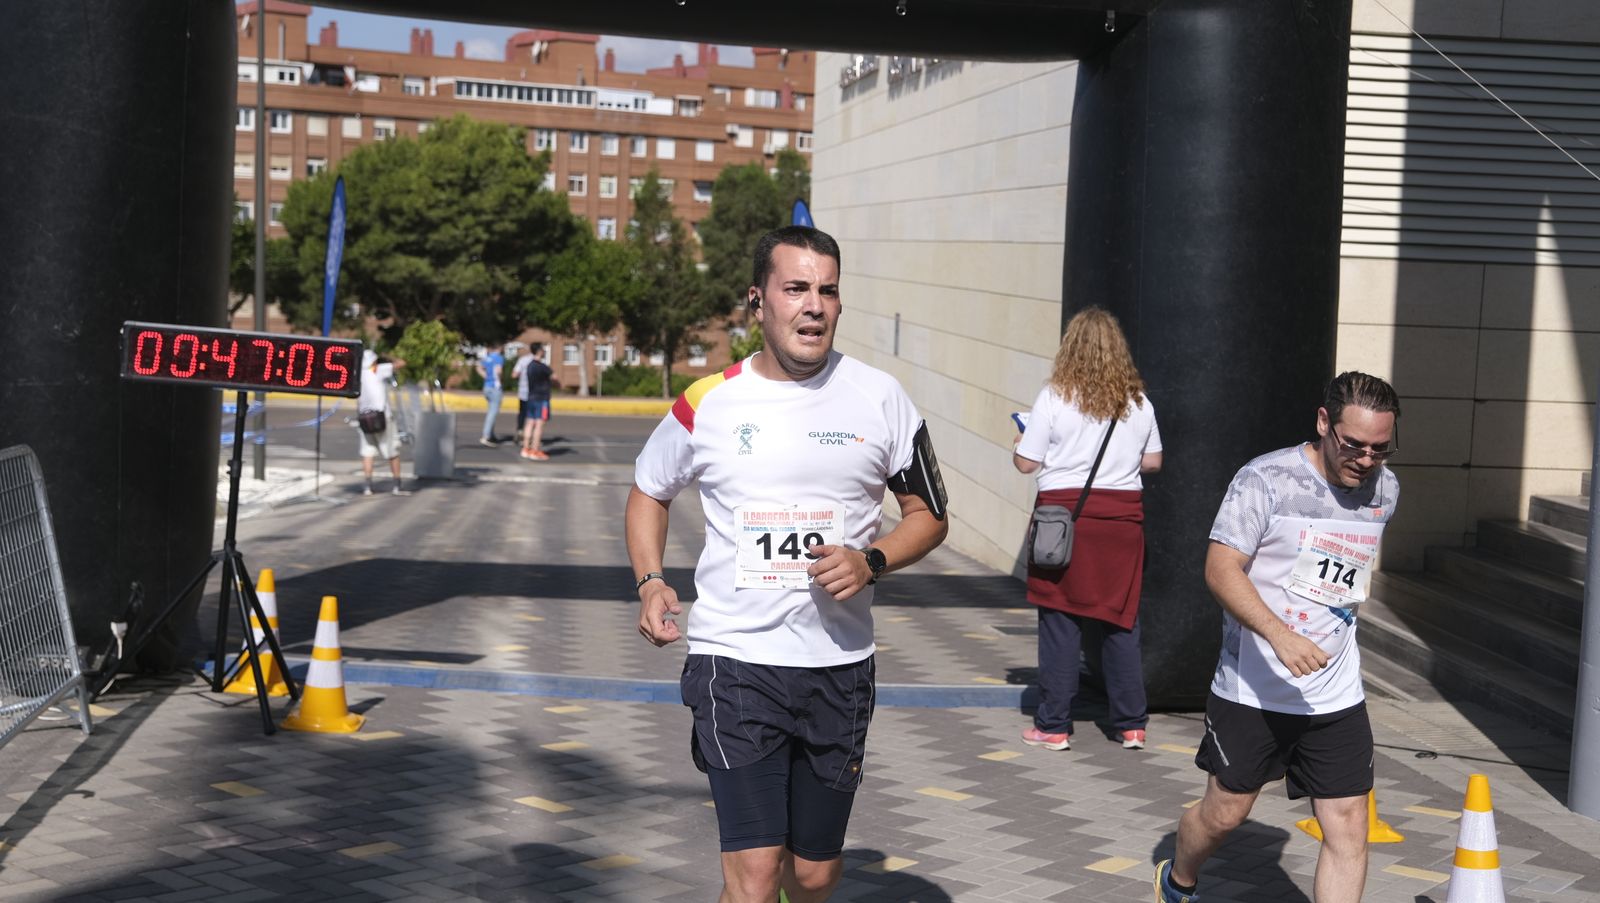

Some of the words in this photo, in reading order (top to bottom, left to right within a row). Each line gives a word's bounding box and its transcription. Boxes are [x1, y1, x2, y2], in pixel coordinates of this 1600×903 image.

[134, 330, 349, 390] 00:47:05
[733, 423, 760, 434] GUARDIA
[808, 431, 857, 440] GUARDIA
[819, 438, 848, 446] CIVIL
[750, 511, 790, 521] CARRERA
[792, 511, 808, 520] SIN
[810, 510, 834, 520] HUMO
[756, 532, 825, 560] 149
[1317, 558, 1357, 590] 174
